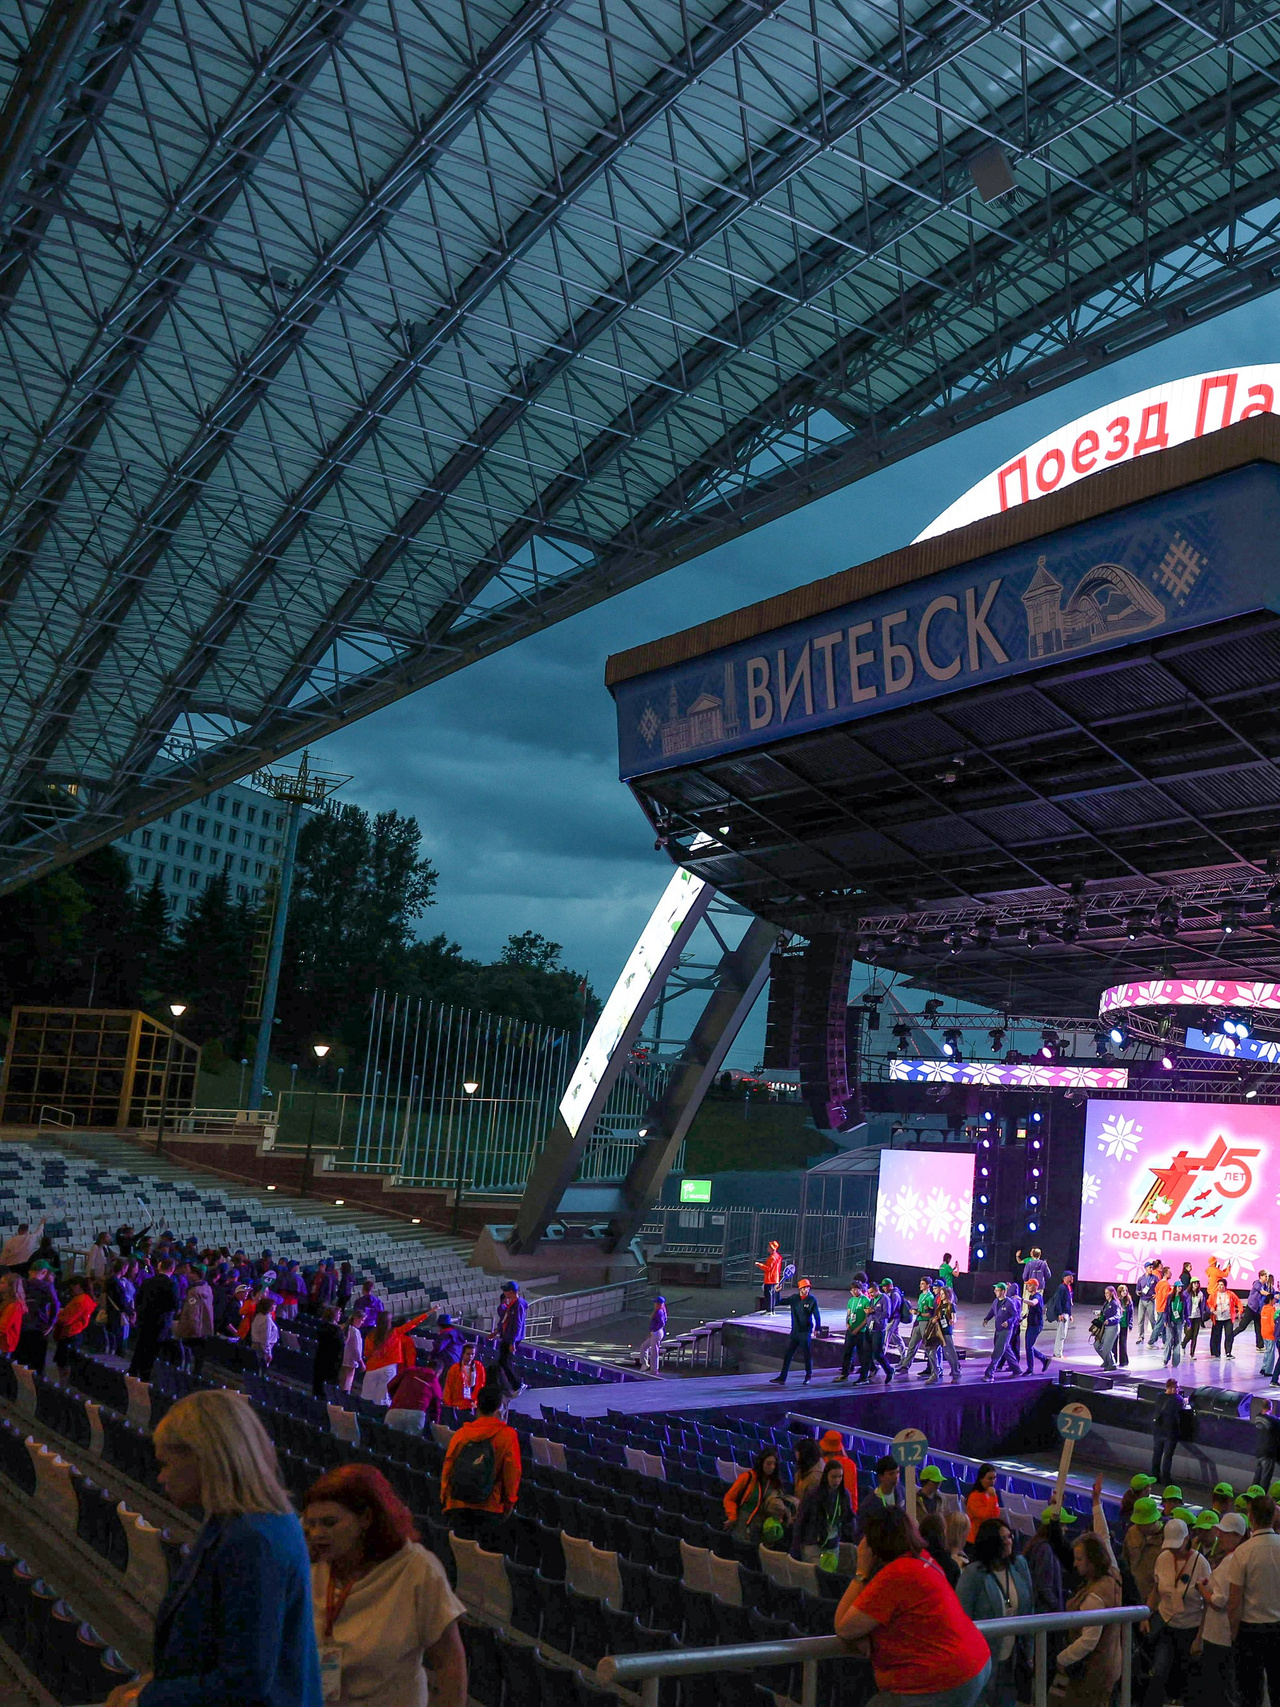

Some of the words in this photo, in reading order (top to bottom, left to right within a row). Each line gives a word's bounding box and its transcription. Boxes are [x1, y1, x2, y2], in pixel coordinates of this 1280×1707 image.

[998, 402, 1169, 512] Поезд
[746, 579, 1009, 731] ВИТЕБСК
[1223, 1172, 1246, 1181] ЛЕТ
[1111, 1227, 1157, 1242] Поезд
[1161, 1229, 1218, 1244] Памяти
[1222, 1232, 1258, 1246] 2026
[1061, 1417, 1085, 1436] 2.1
[898, 1444, 922, 1462] 1.2
